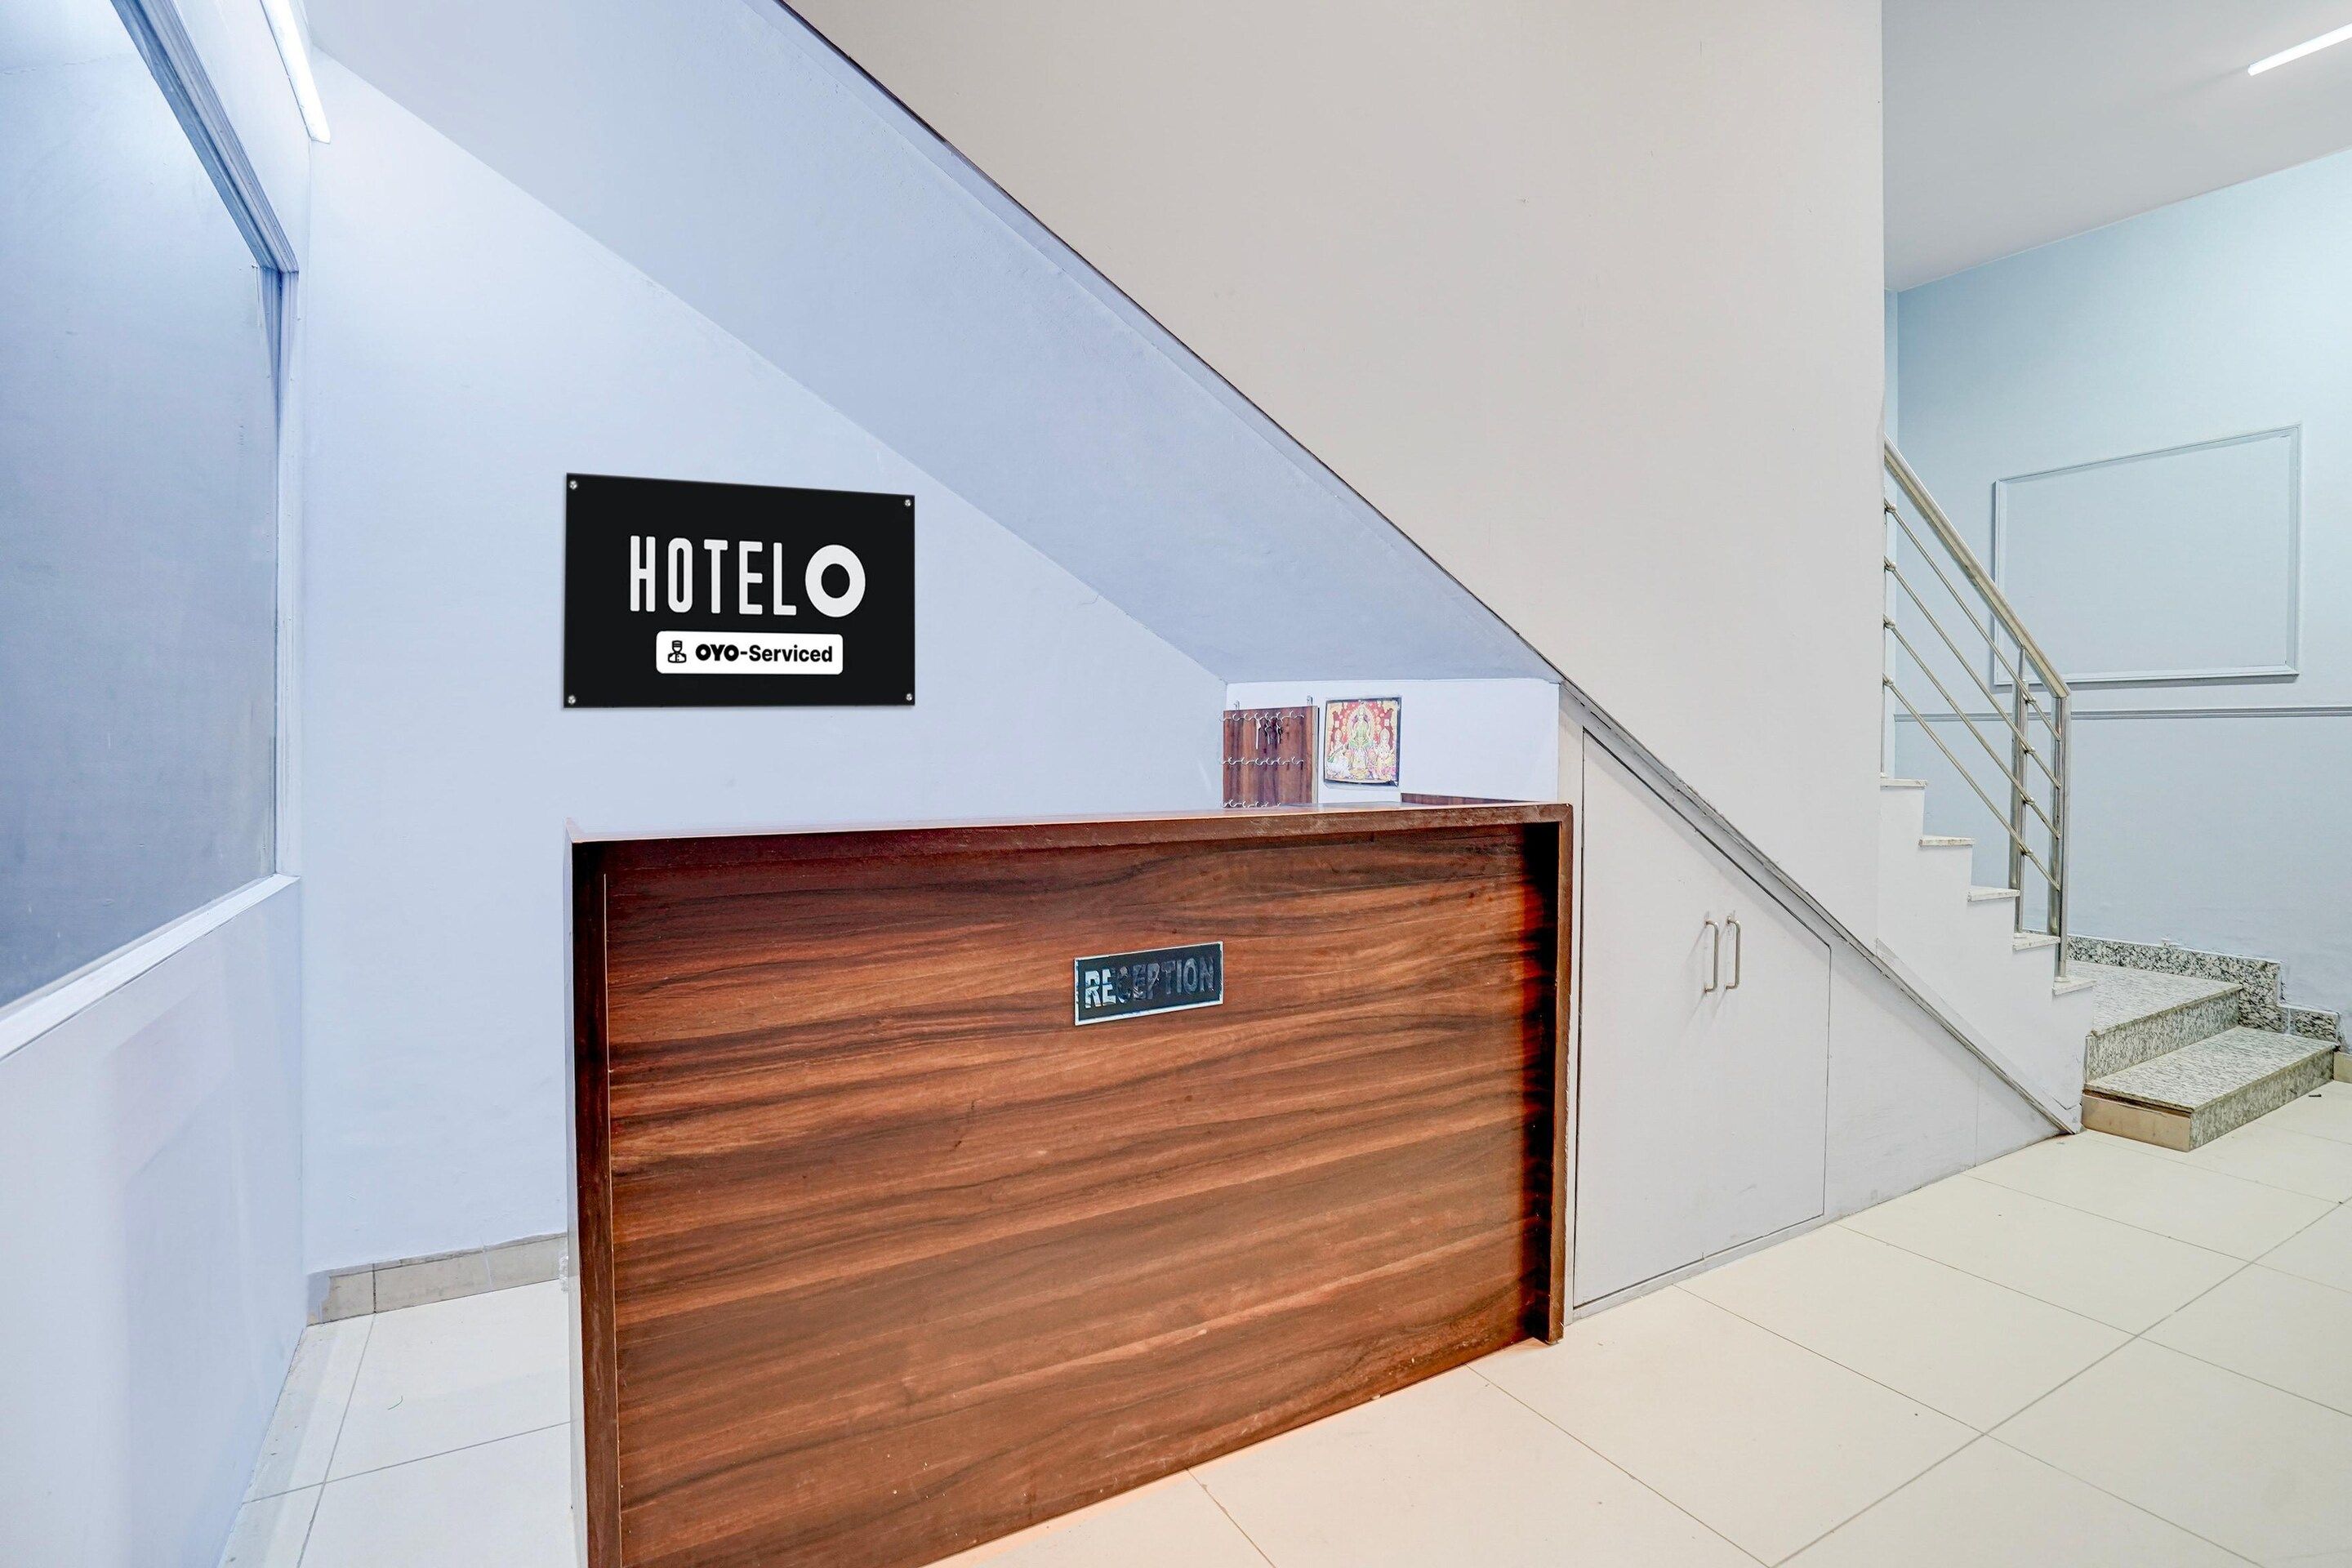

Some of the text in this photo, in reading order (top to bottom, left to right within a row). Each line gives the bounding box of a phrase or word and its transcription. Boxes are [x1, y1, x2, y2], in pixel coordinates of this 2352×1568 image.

[630, 535, 866, 617] HOTEL O
[695, 644, 833, 663] OYO-Serviced
